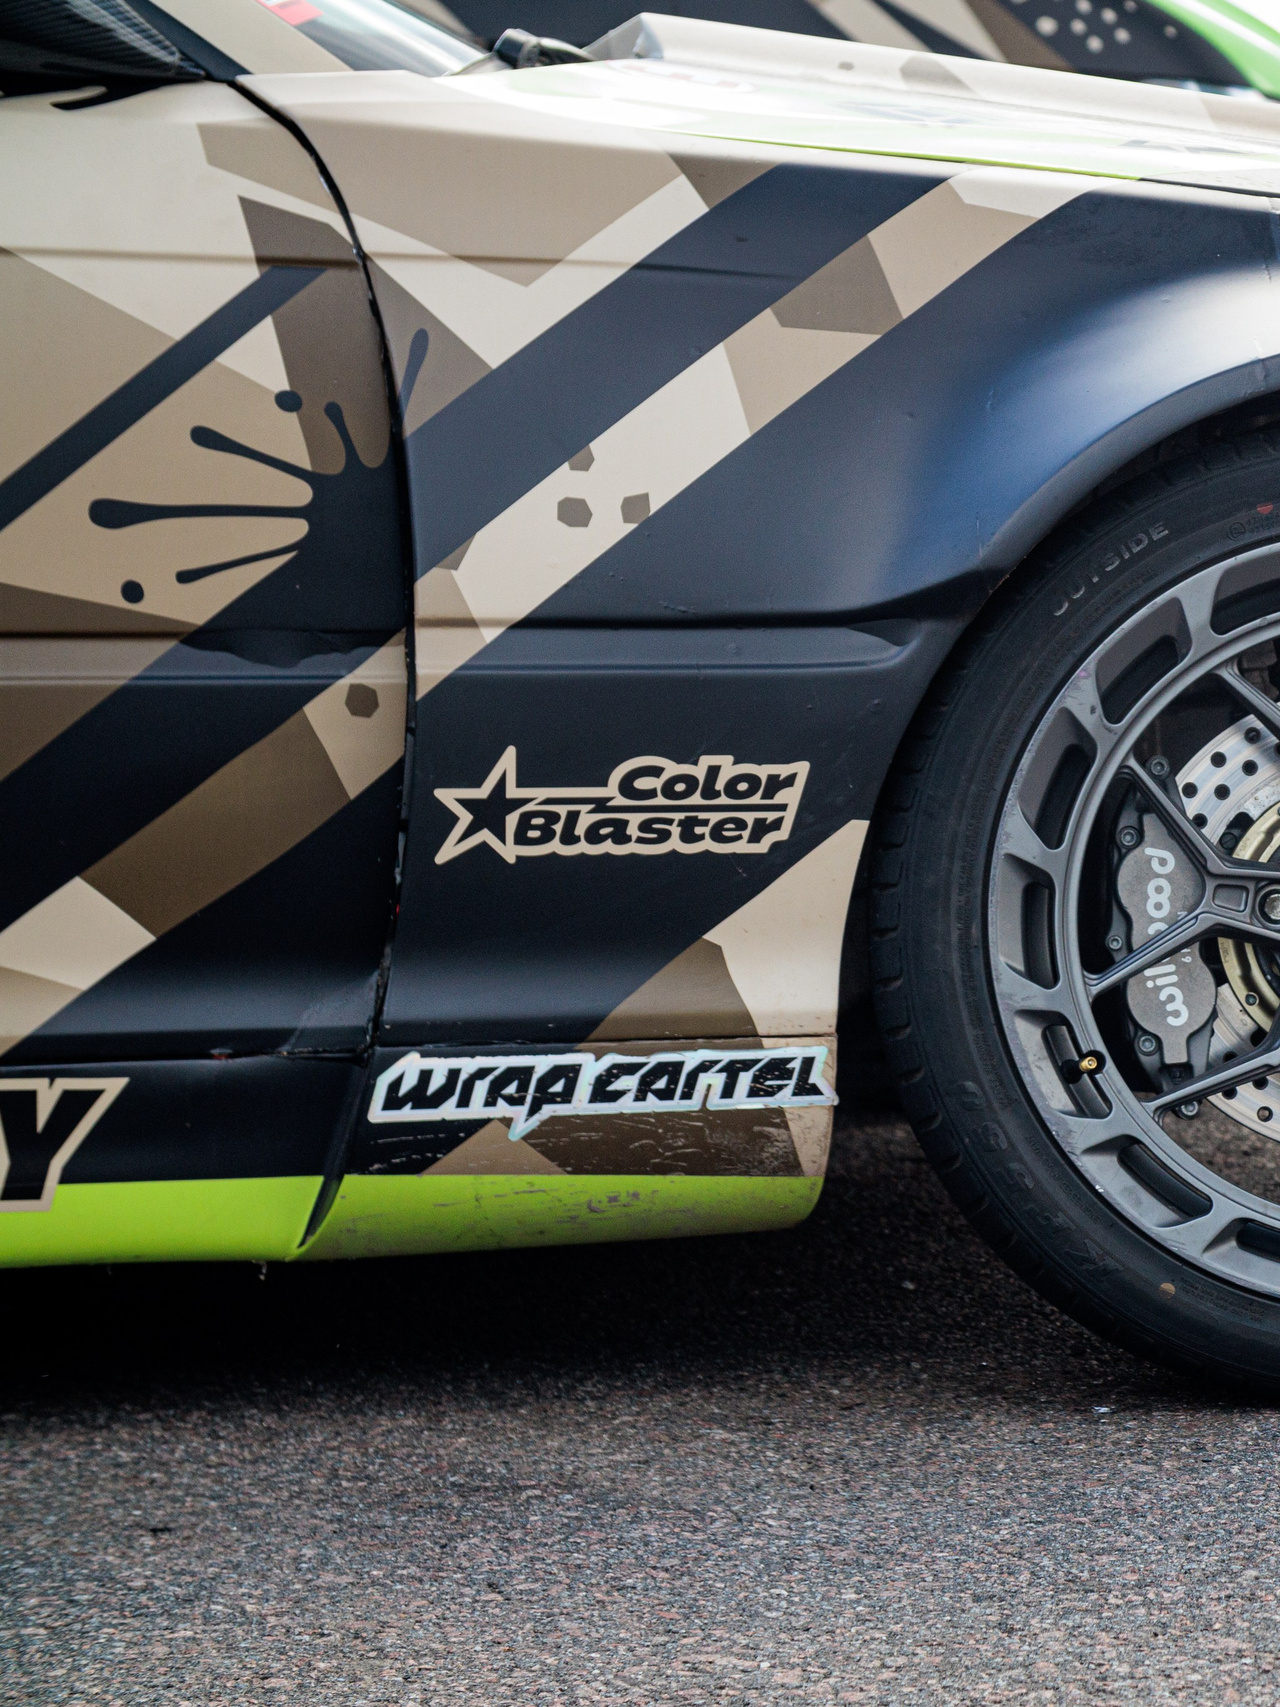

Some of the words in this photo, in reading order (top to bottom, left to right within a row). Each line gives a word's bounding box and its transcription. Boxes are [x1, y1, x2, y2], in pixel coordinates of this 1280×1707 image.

[1051, 521, 1170, 616] OUTSIDE
[616, 764, 799, 801] Color
[512, 809, 784, 847] Blaster
